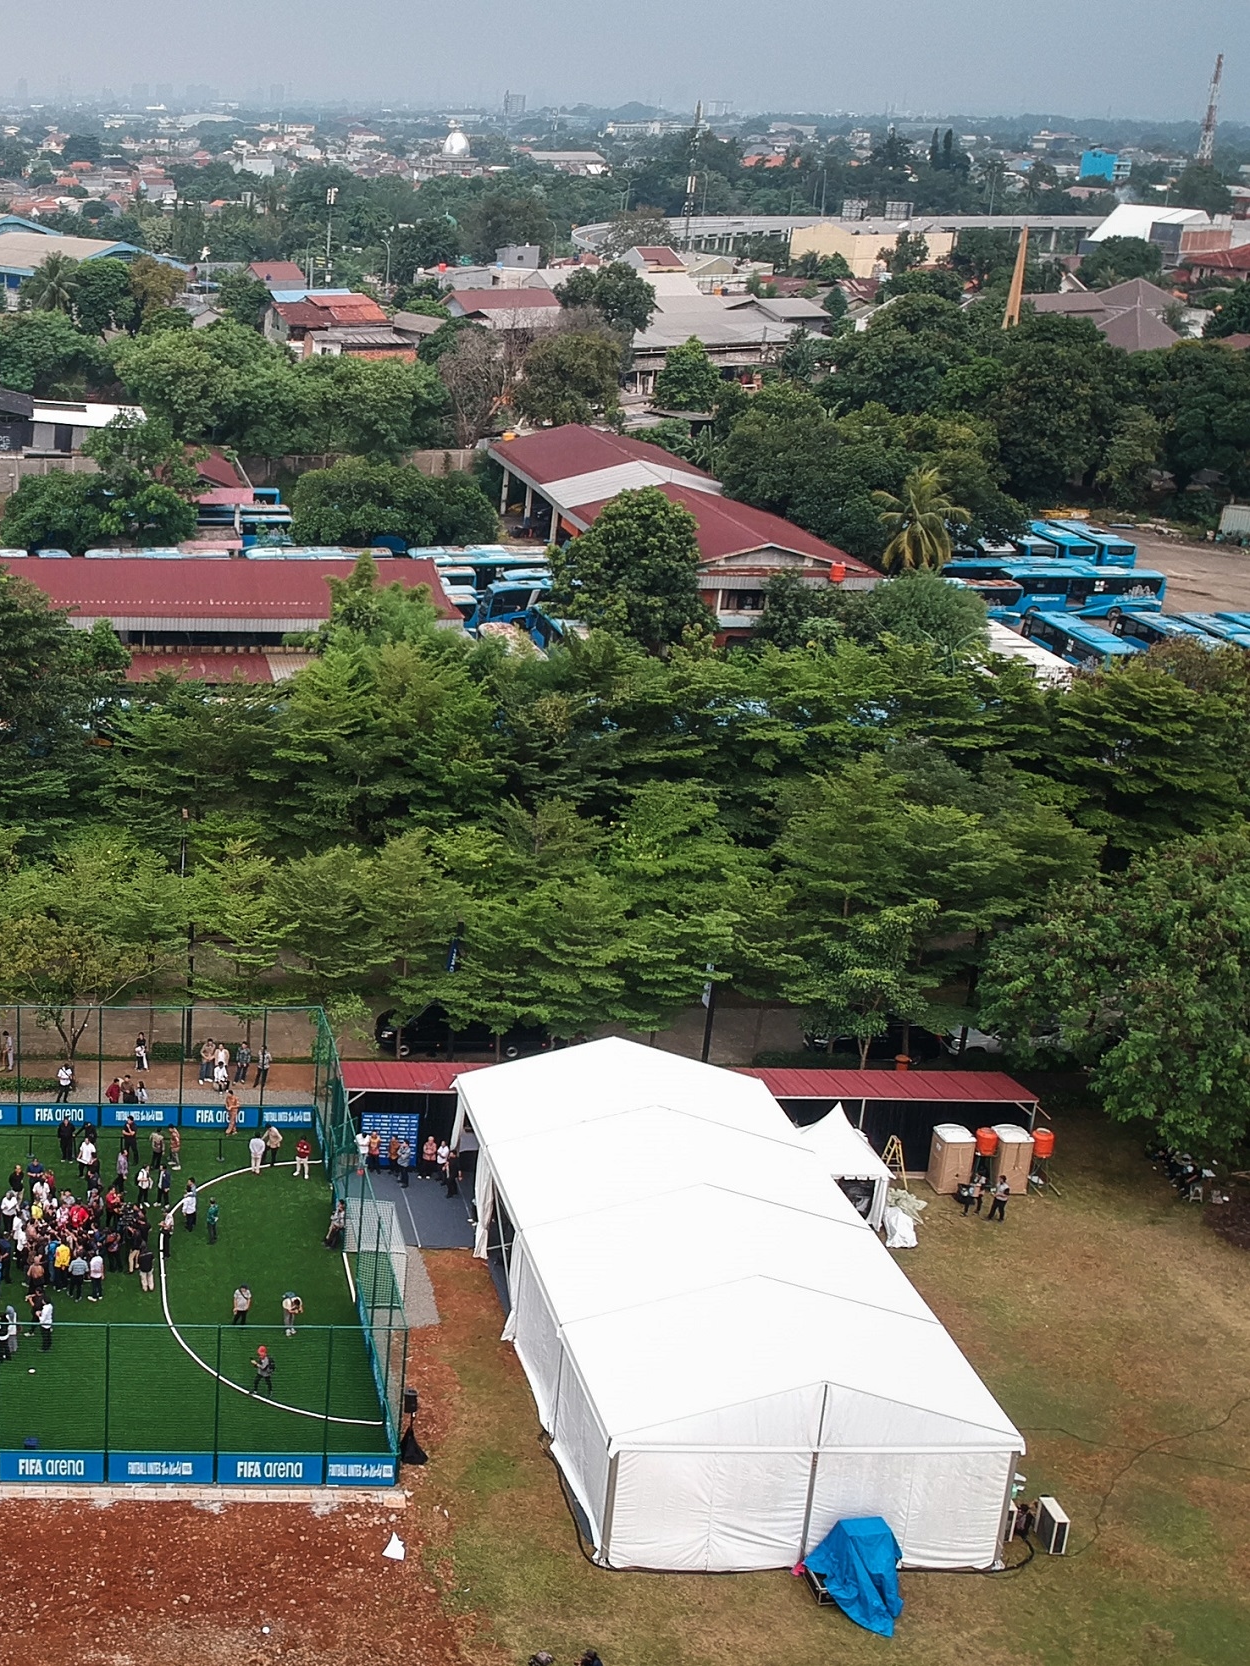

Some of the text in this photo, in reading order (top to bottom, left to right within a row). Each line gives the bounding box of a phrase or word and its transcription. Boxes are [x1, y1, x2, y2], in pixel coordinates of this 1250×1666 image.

[35, 1108, 84, 1122] FIFA arena
[196, 1110, 214, 1123] FIFA
[18, 1458, 84, 1476] FIFA arena
[237, 1462, 303, 1478] FIFA arena
